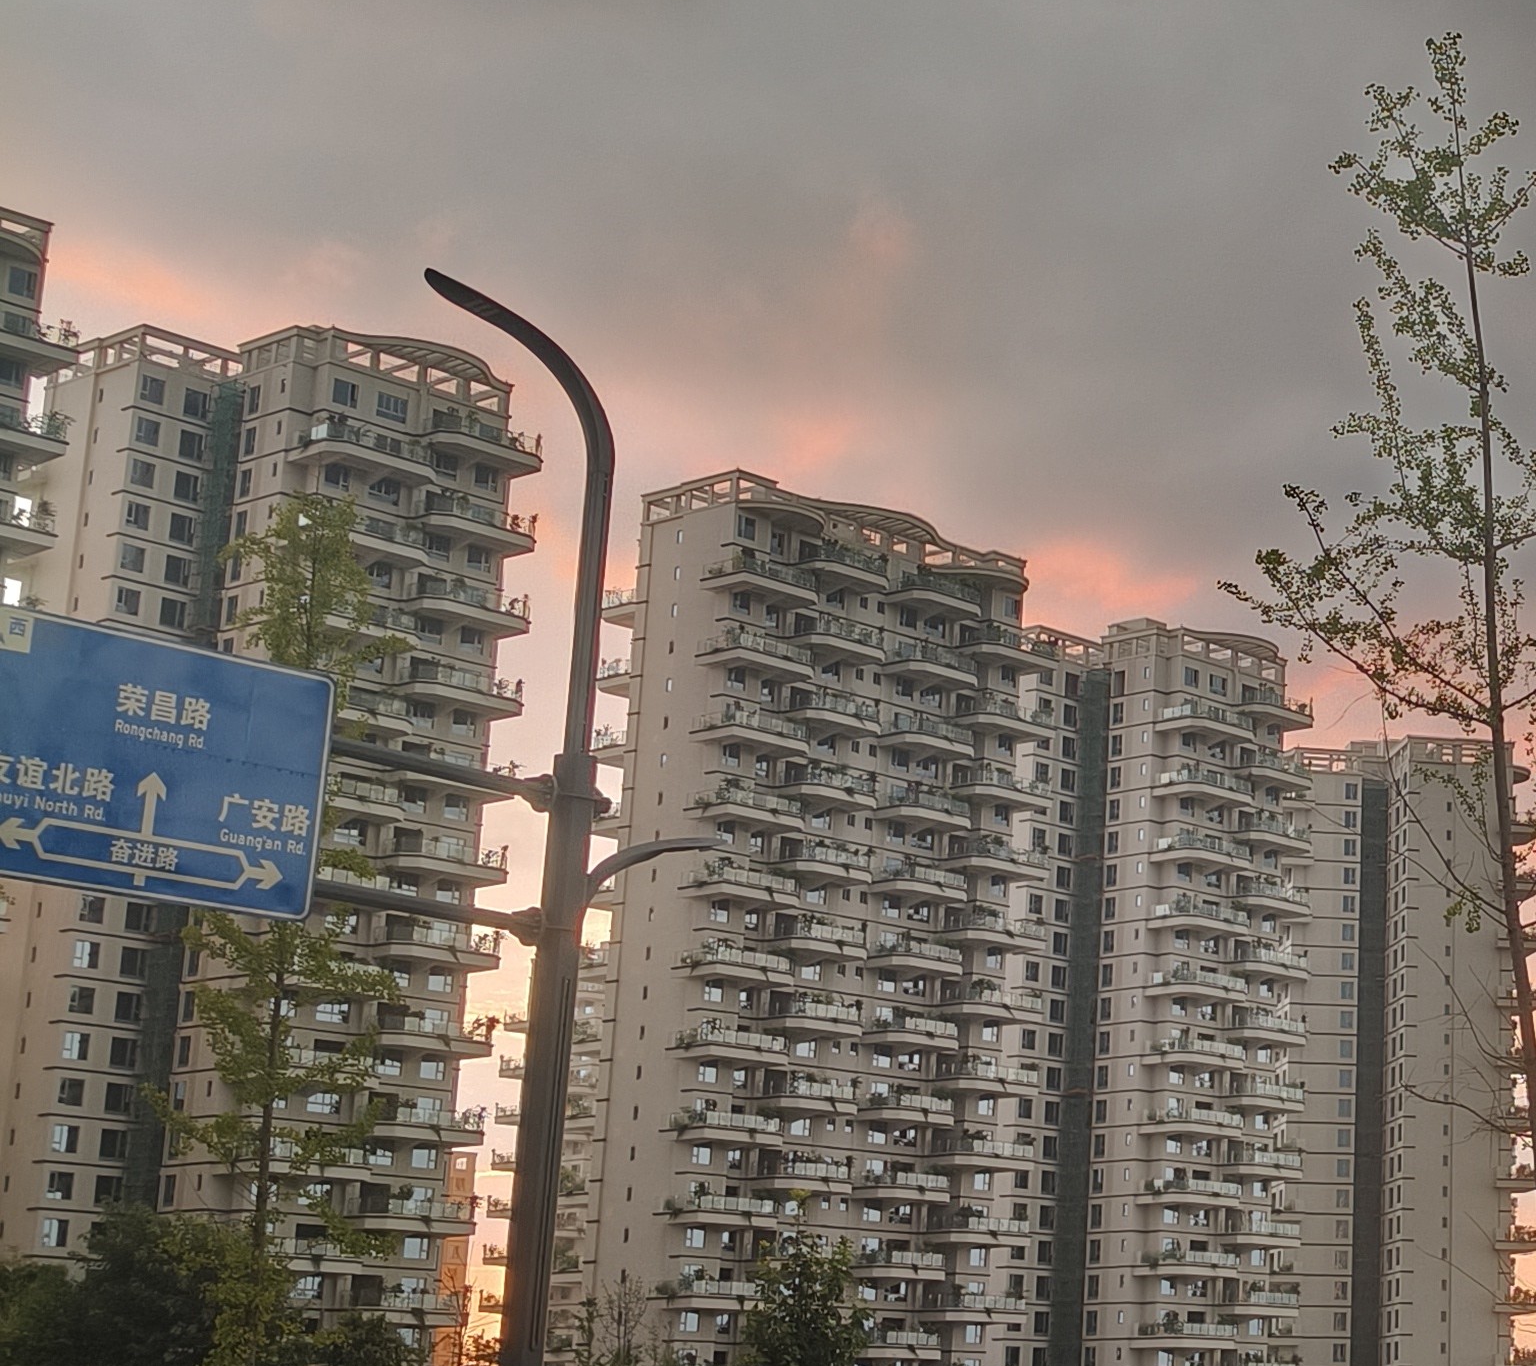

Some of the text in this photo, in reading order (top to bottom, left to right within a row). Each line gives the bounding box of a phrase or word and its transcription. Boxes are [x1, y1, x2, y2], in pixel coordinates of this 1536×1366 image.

[115, 683, 211, 731] 荣昌路
[114, 718, 184, 749] Rongchang
[34, 795, 78, 817] North
[84, 804, 106, 822] Rd.
[218, 793, 311, 837] 广安路
[110, 838, 178, 871] 奋进路
[220, 828, 306, 856] Guang'an Rd.
